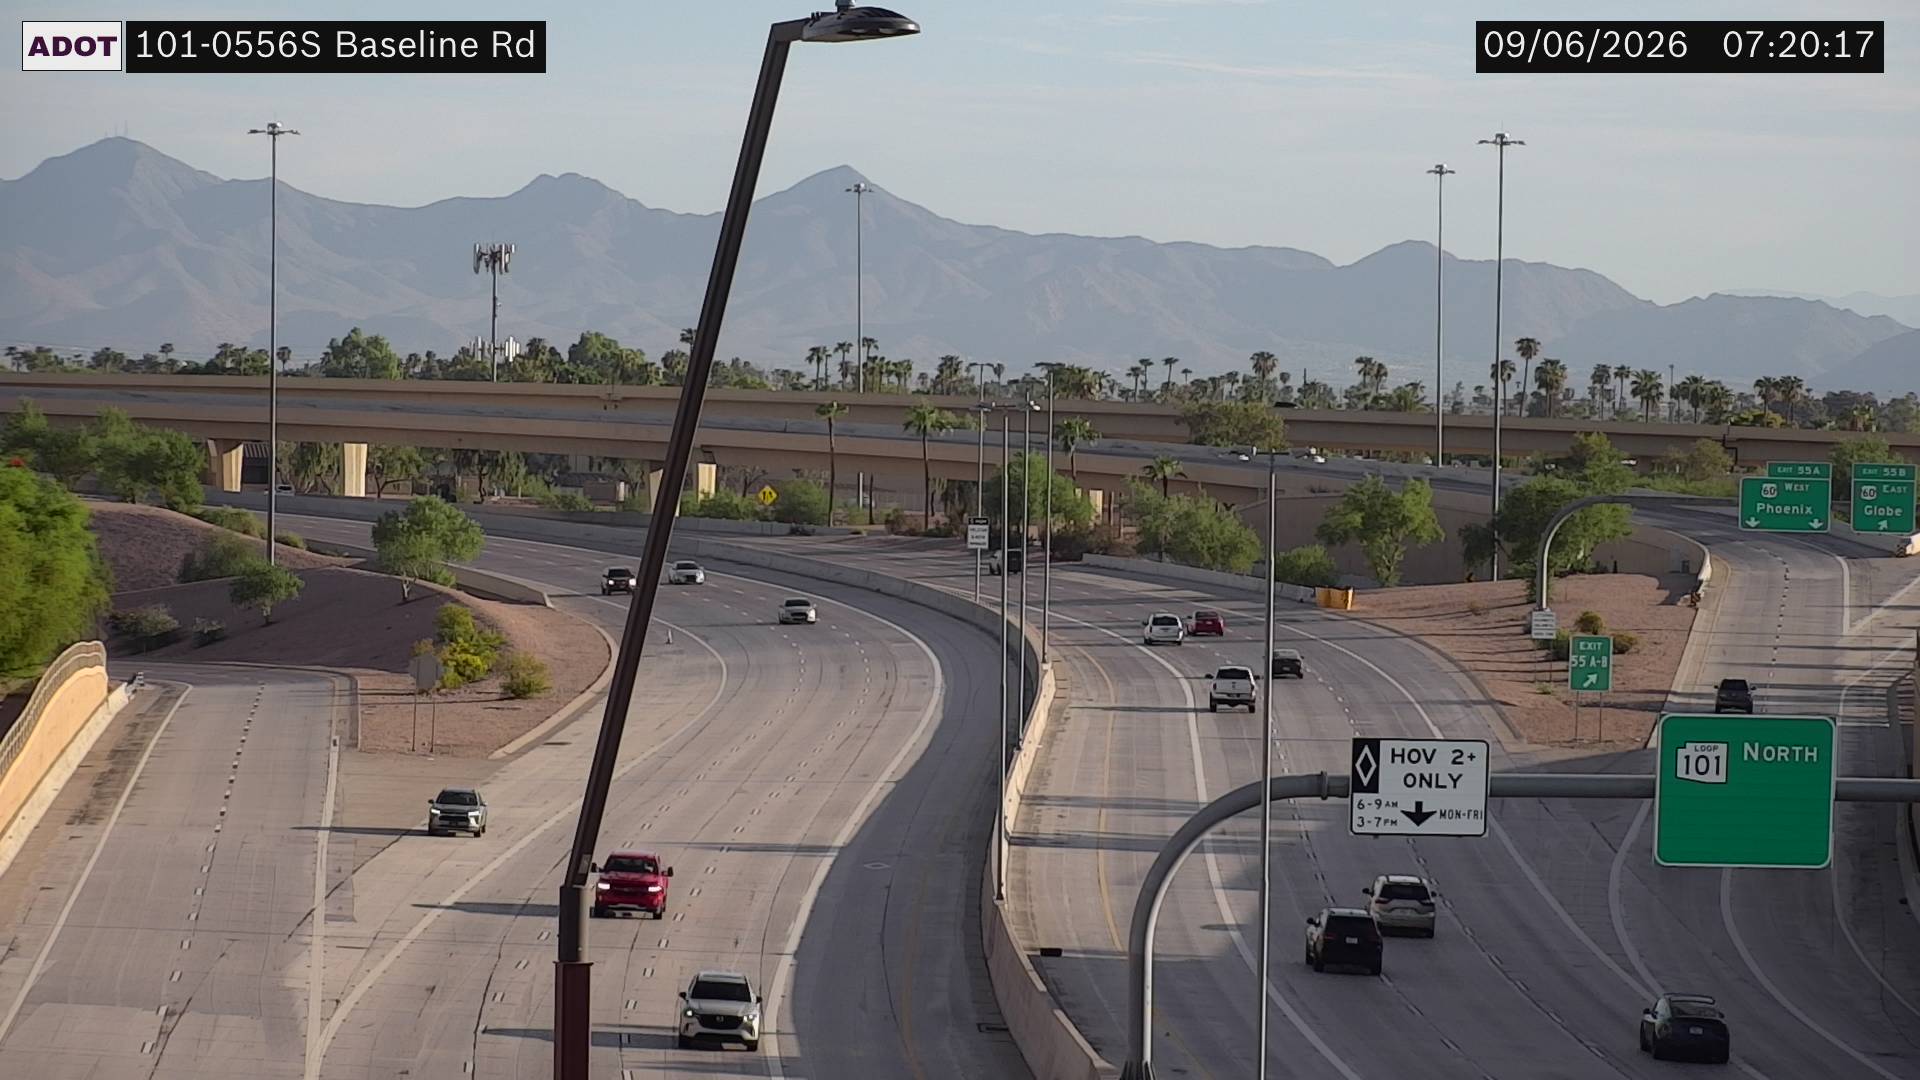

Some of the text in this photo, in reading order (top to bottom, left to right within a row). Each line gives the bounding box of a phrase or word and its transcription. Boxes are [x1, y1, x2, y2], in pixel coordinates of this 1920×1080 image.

[1763, 486, 1776, 496] 60
[1784, 482, 1810, 492] WEST
[1882, 484, 1908, 493] EAST
[1862, 488, 1876, 498] 60
[1756, 502, 1813, 515] Phoenix
[1864, 505, 1903, 517] Globe
[1579, 641, 1602, 651] EXIT
[1391, 747, 1476, 765] HOV 2+
[1743, 742, 1817, 762] NORTH
[1684, 755, 1720, 776] 101
[1403, 772, 1463, 789] ONLY
[1440, 809, 1482, 820] MON-FRI
